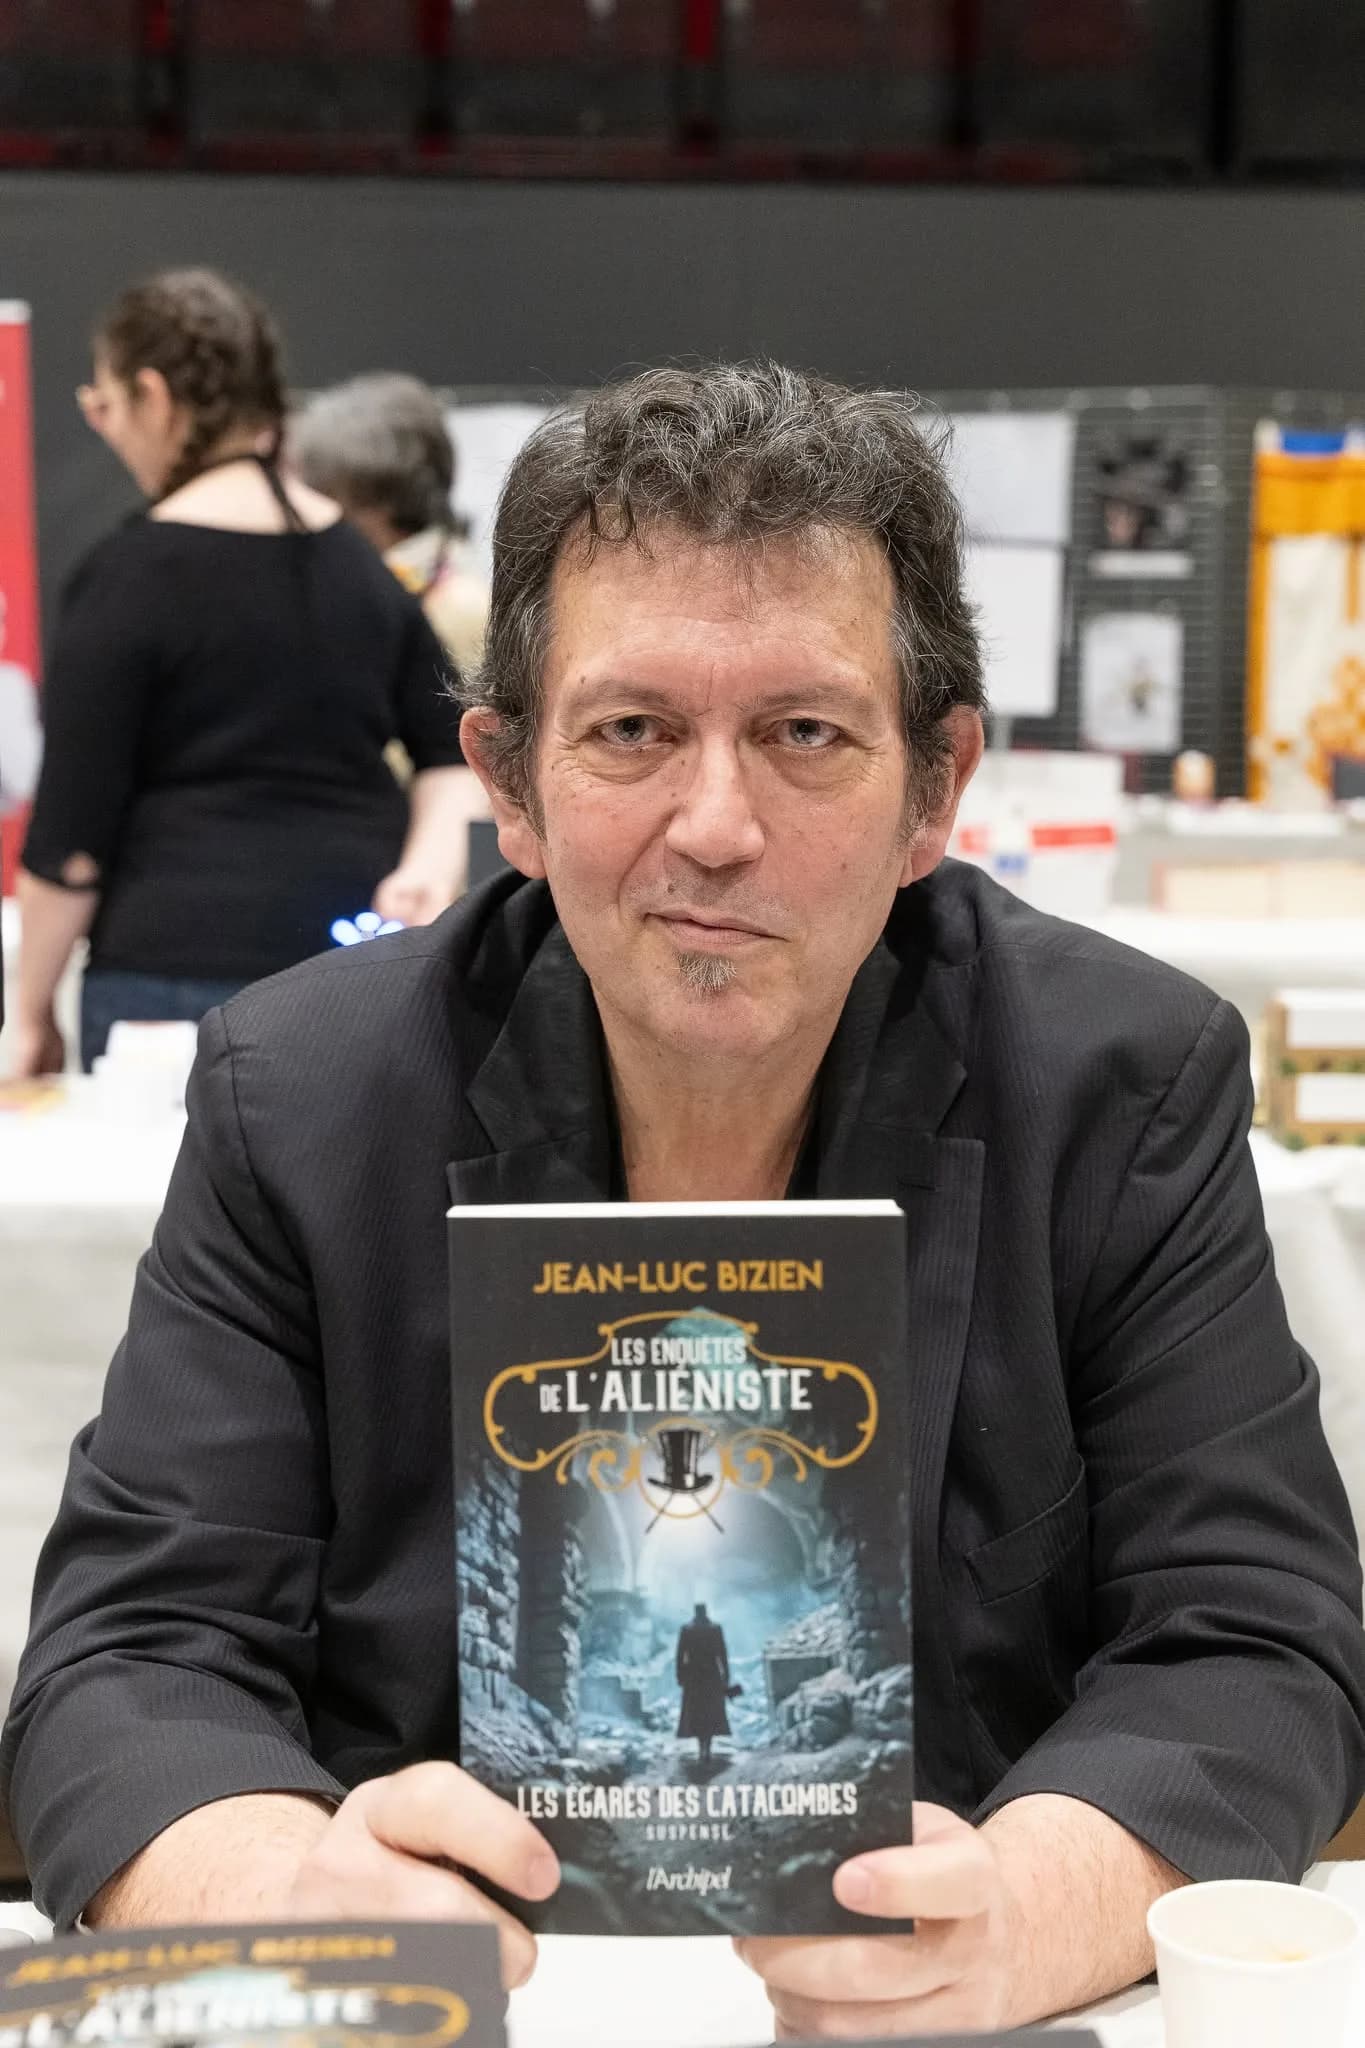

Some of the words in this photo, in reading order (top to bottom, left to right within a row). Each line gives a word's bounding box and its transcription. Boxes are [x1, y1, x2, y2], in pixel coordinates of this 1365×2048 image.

[533, 1262, 705, 1293] JEAN-LUC
[717, 1260, 824, 1292] BIZIEN
[611, 1337, 646, 1366] LES
[539, 1384, 562, 1412] DE
[517, 1786, 559, 1819] LES
[658, 1785, 699, 1818] DES
[706, 1783, 858, 1817] CATACOMBES
[646, 1823, 734, 1841] SUSPENSE
